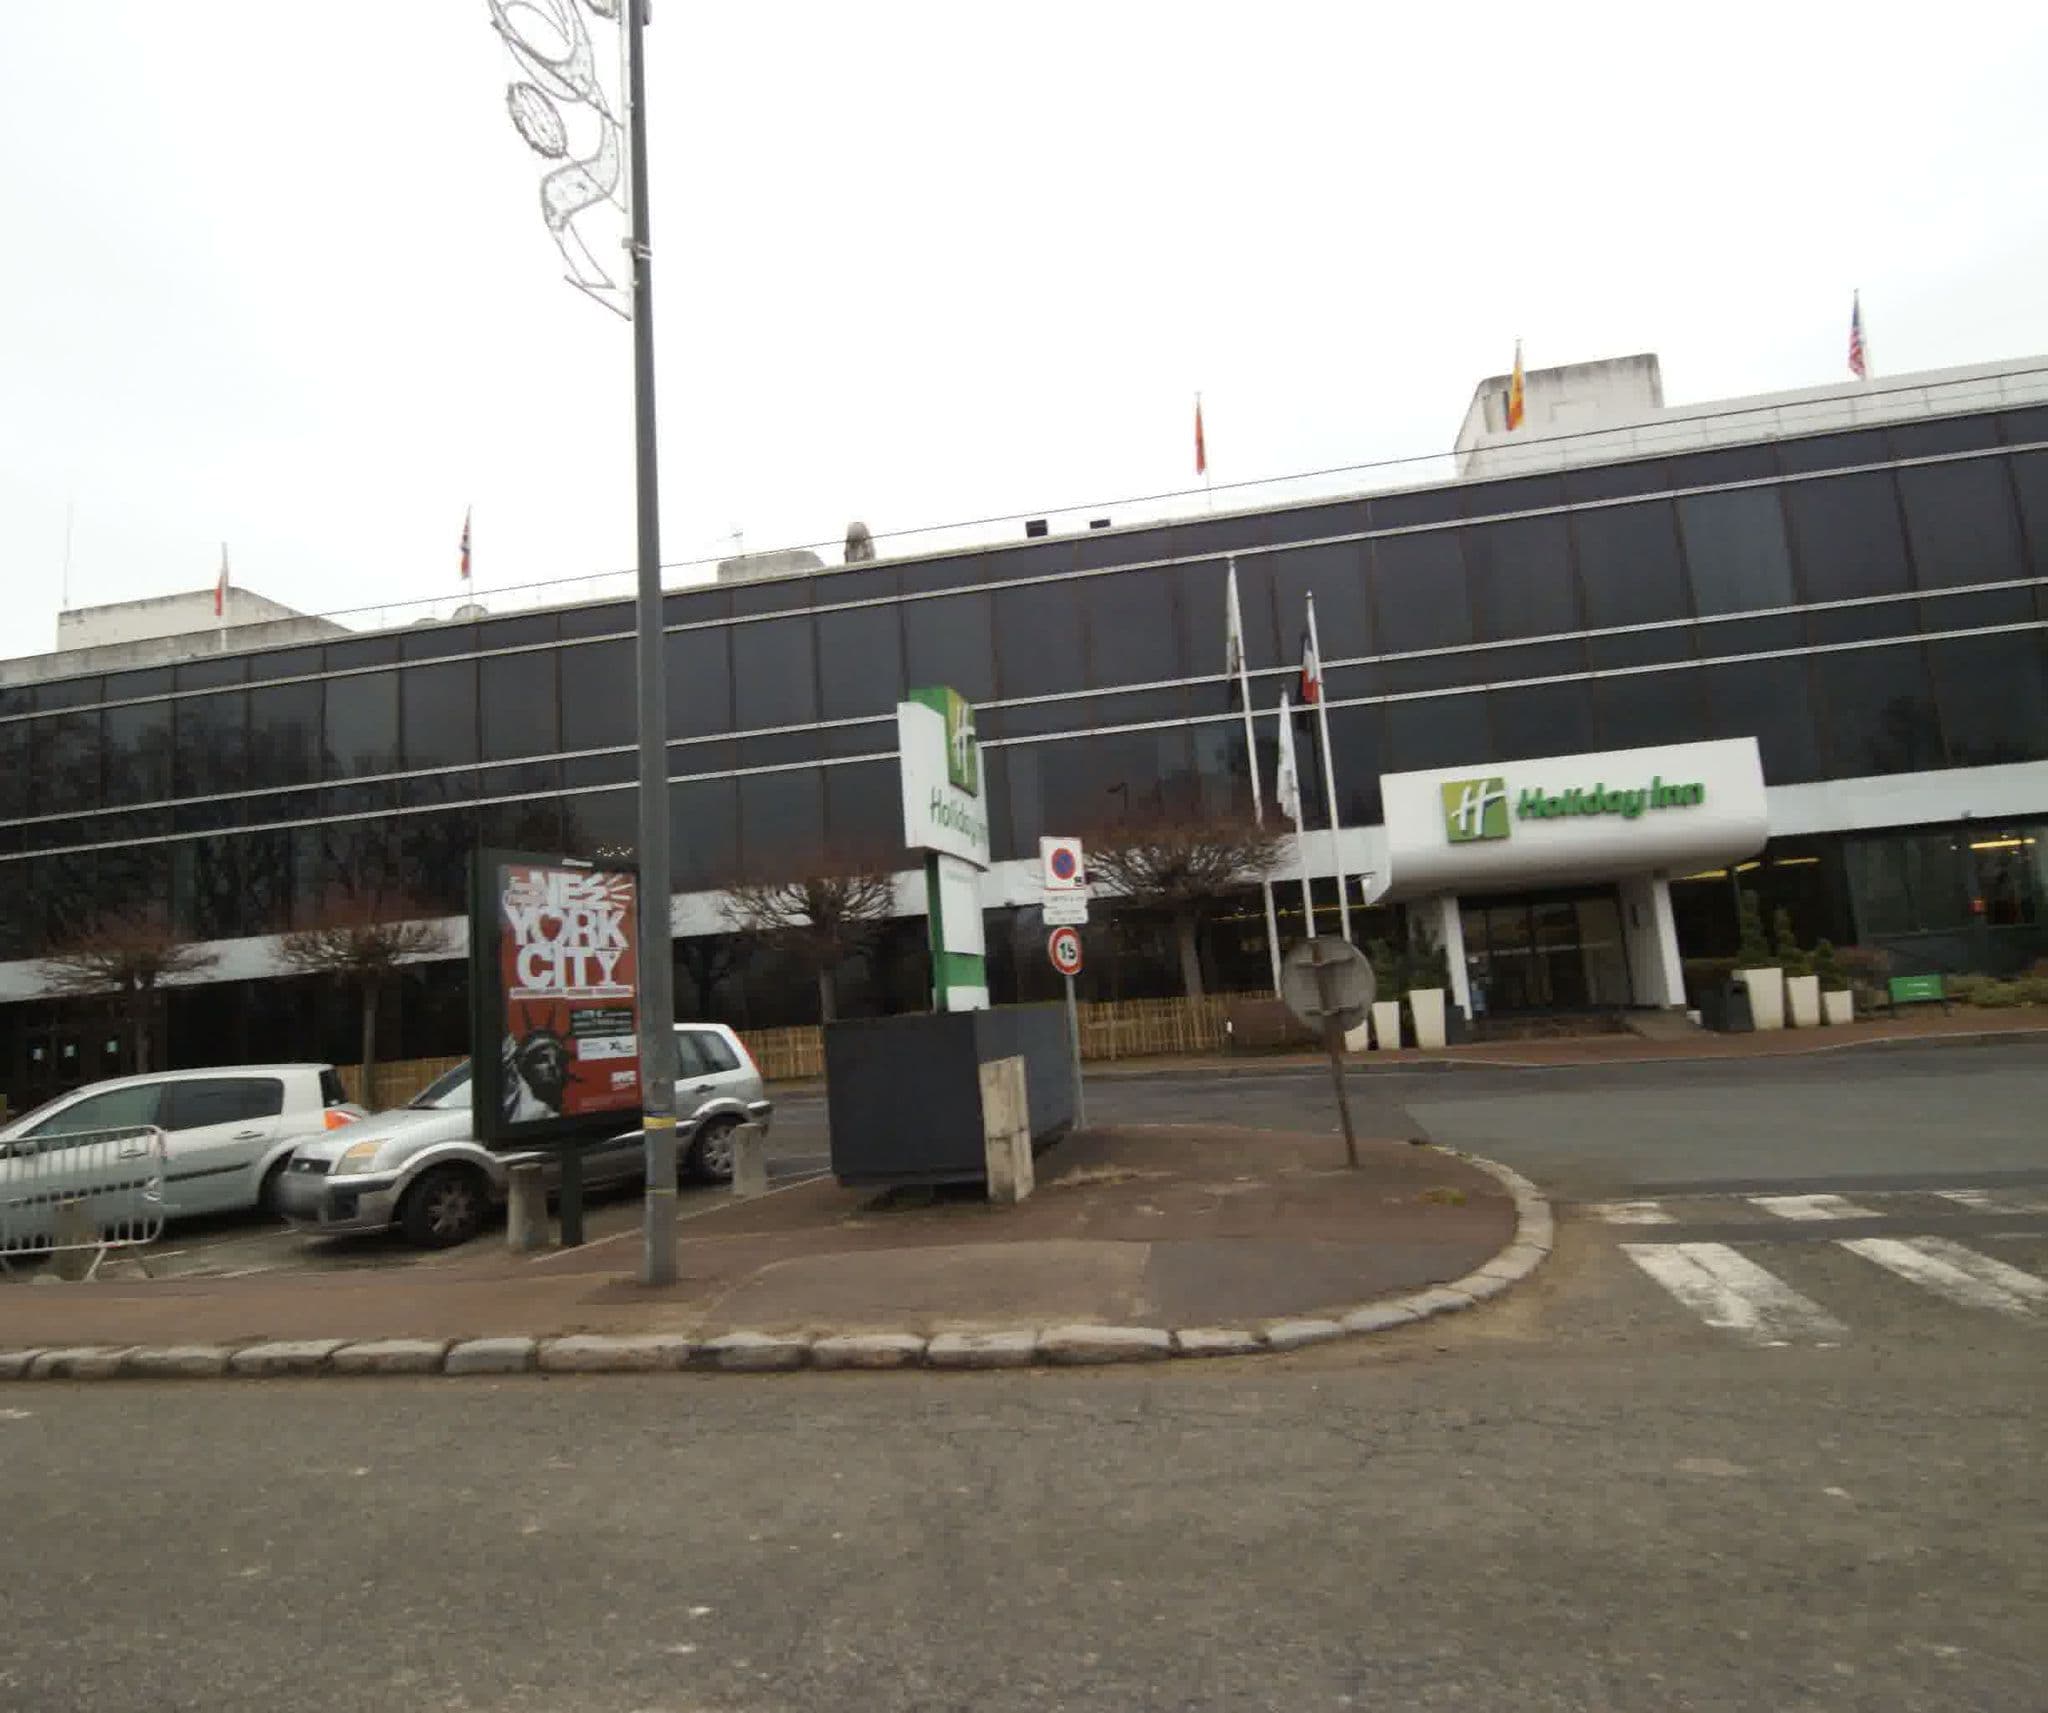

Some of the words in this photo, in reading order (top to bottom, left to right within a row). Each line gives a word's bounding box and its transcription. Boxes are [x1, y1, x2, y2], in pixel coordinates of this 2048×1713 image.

[1517, 782, 1646, 818] Holiday
[1650, 776, 1706, 808] Inn
[504, 905, 629, 950] YORK
[518, 942, 623, 989] CITY
[1059, 941, 1077, 960] 15
